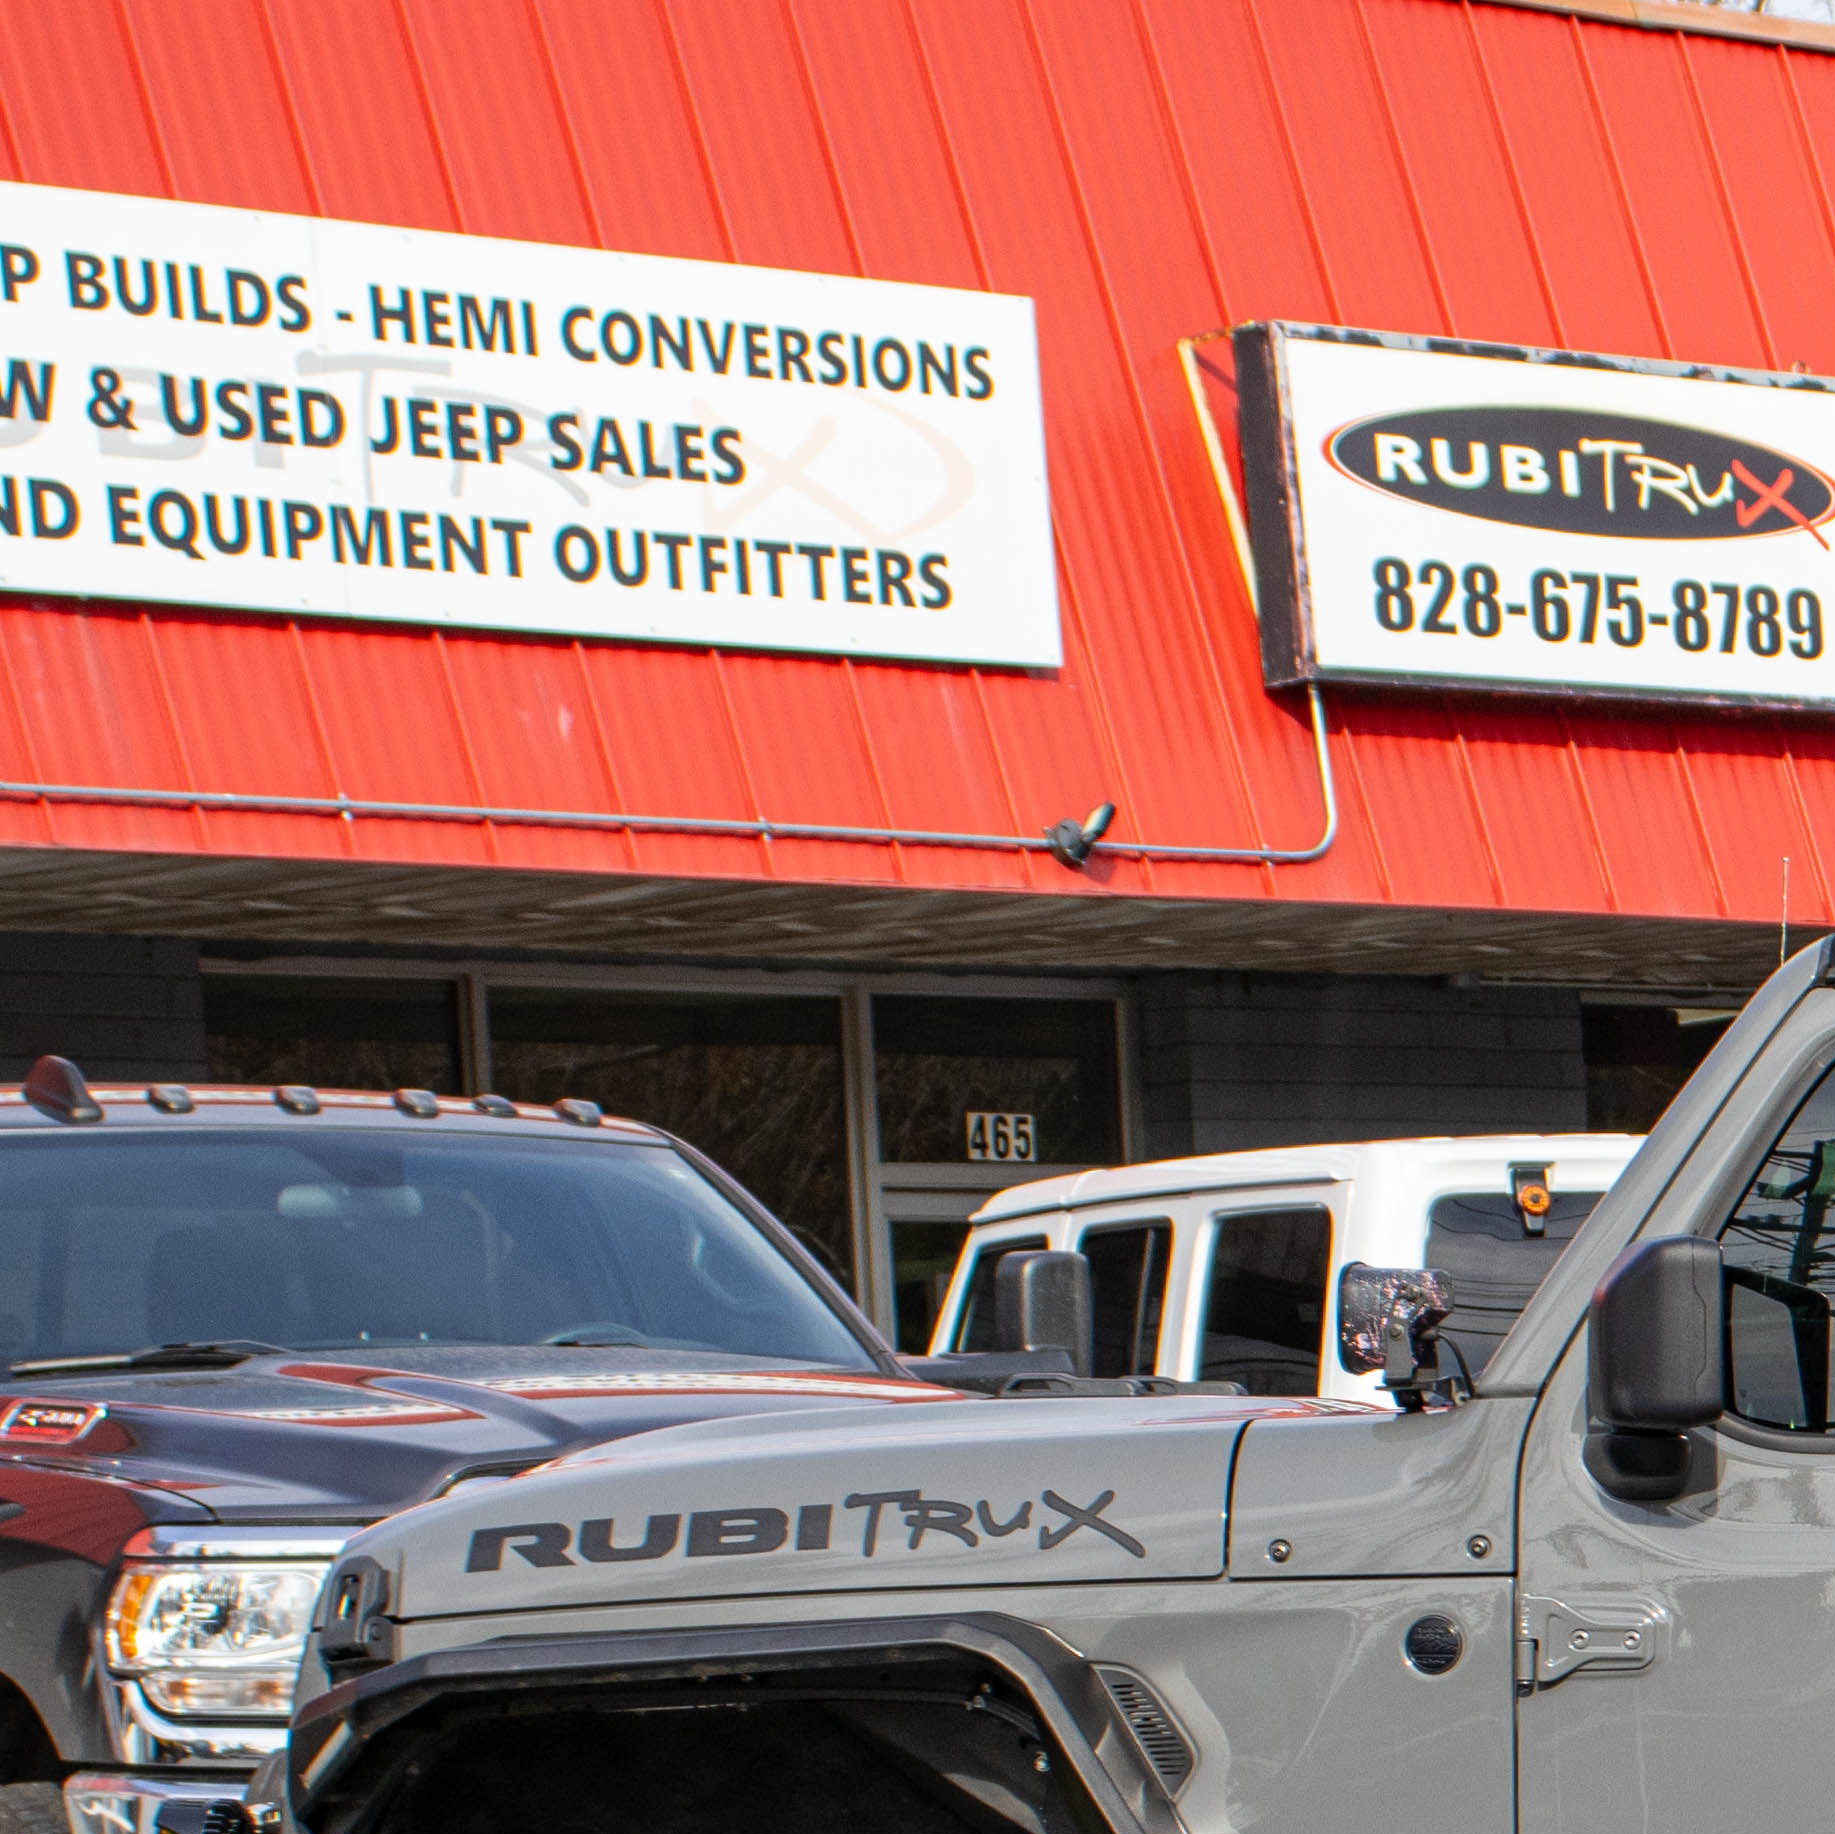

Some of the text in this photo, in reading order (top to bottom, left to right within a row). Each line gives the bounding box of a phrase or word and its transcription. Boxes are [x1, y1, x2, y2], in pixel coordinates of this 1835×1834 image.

[65, 250, 312, 332] BUILDS
[368, 283, 538, 356] HEMI
[562, 305, 994, 400] CONVERSIONS
[87, 366, 138, 430] &
[160, 372, 346, 448] USED
[369, 392, 523, 464] JEEP
[549, 412, 746, 484] SALES
[106, 484, 531, 577] EQUIPMENT
[554, 524, 953, 609] OUTFITTERS
[1372, 556, 1825, 661] 828-675-8789
[968, 1114, 1032, 1160] 465
